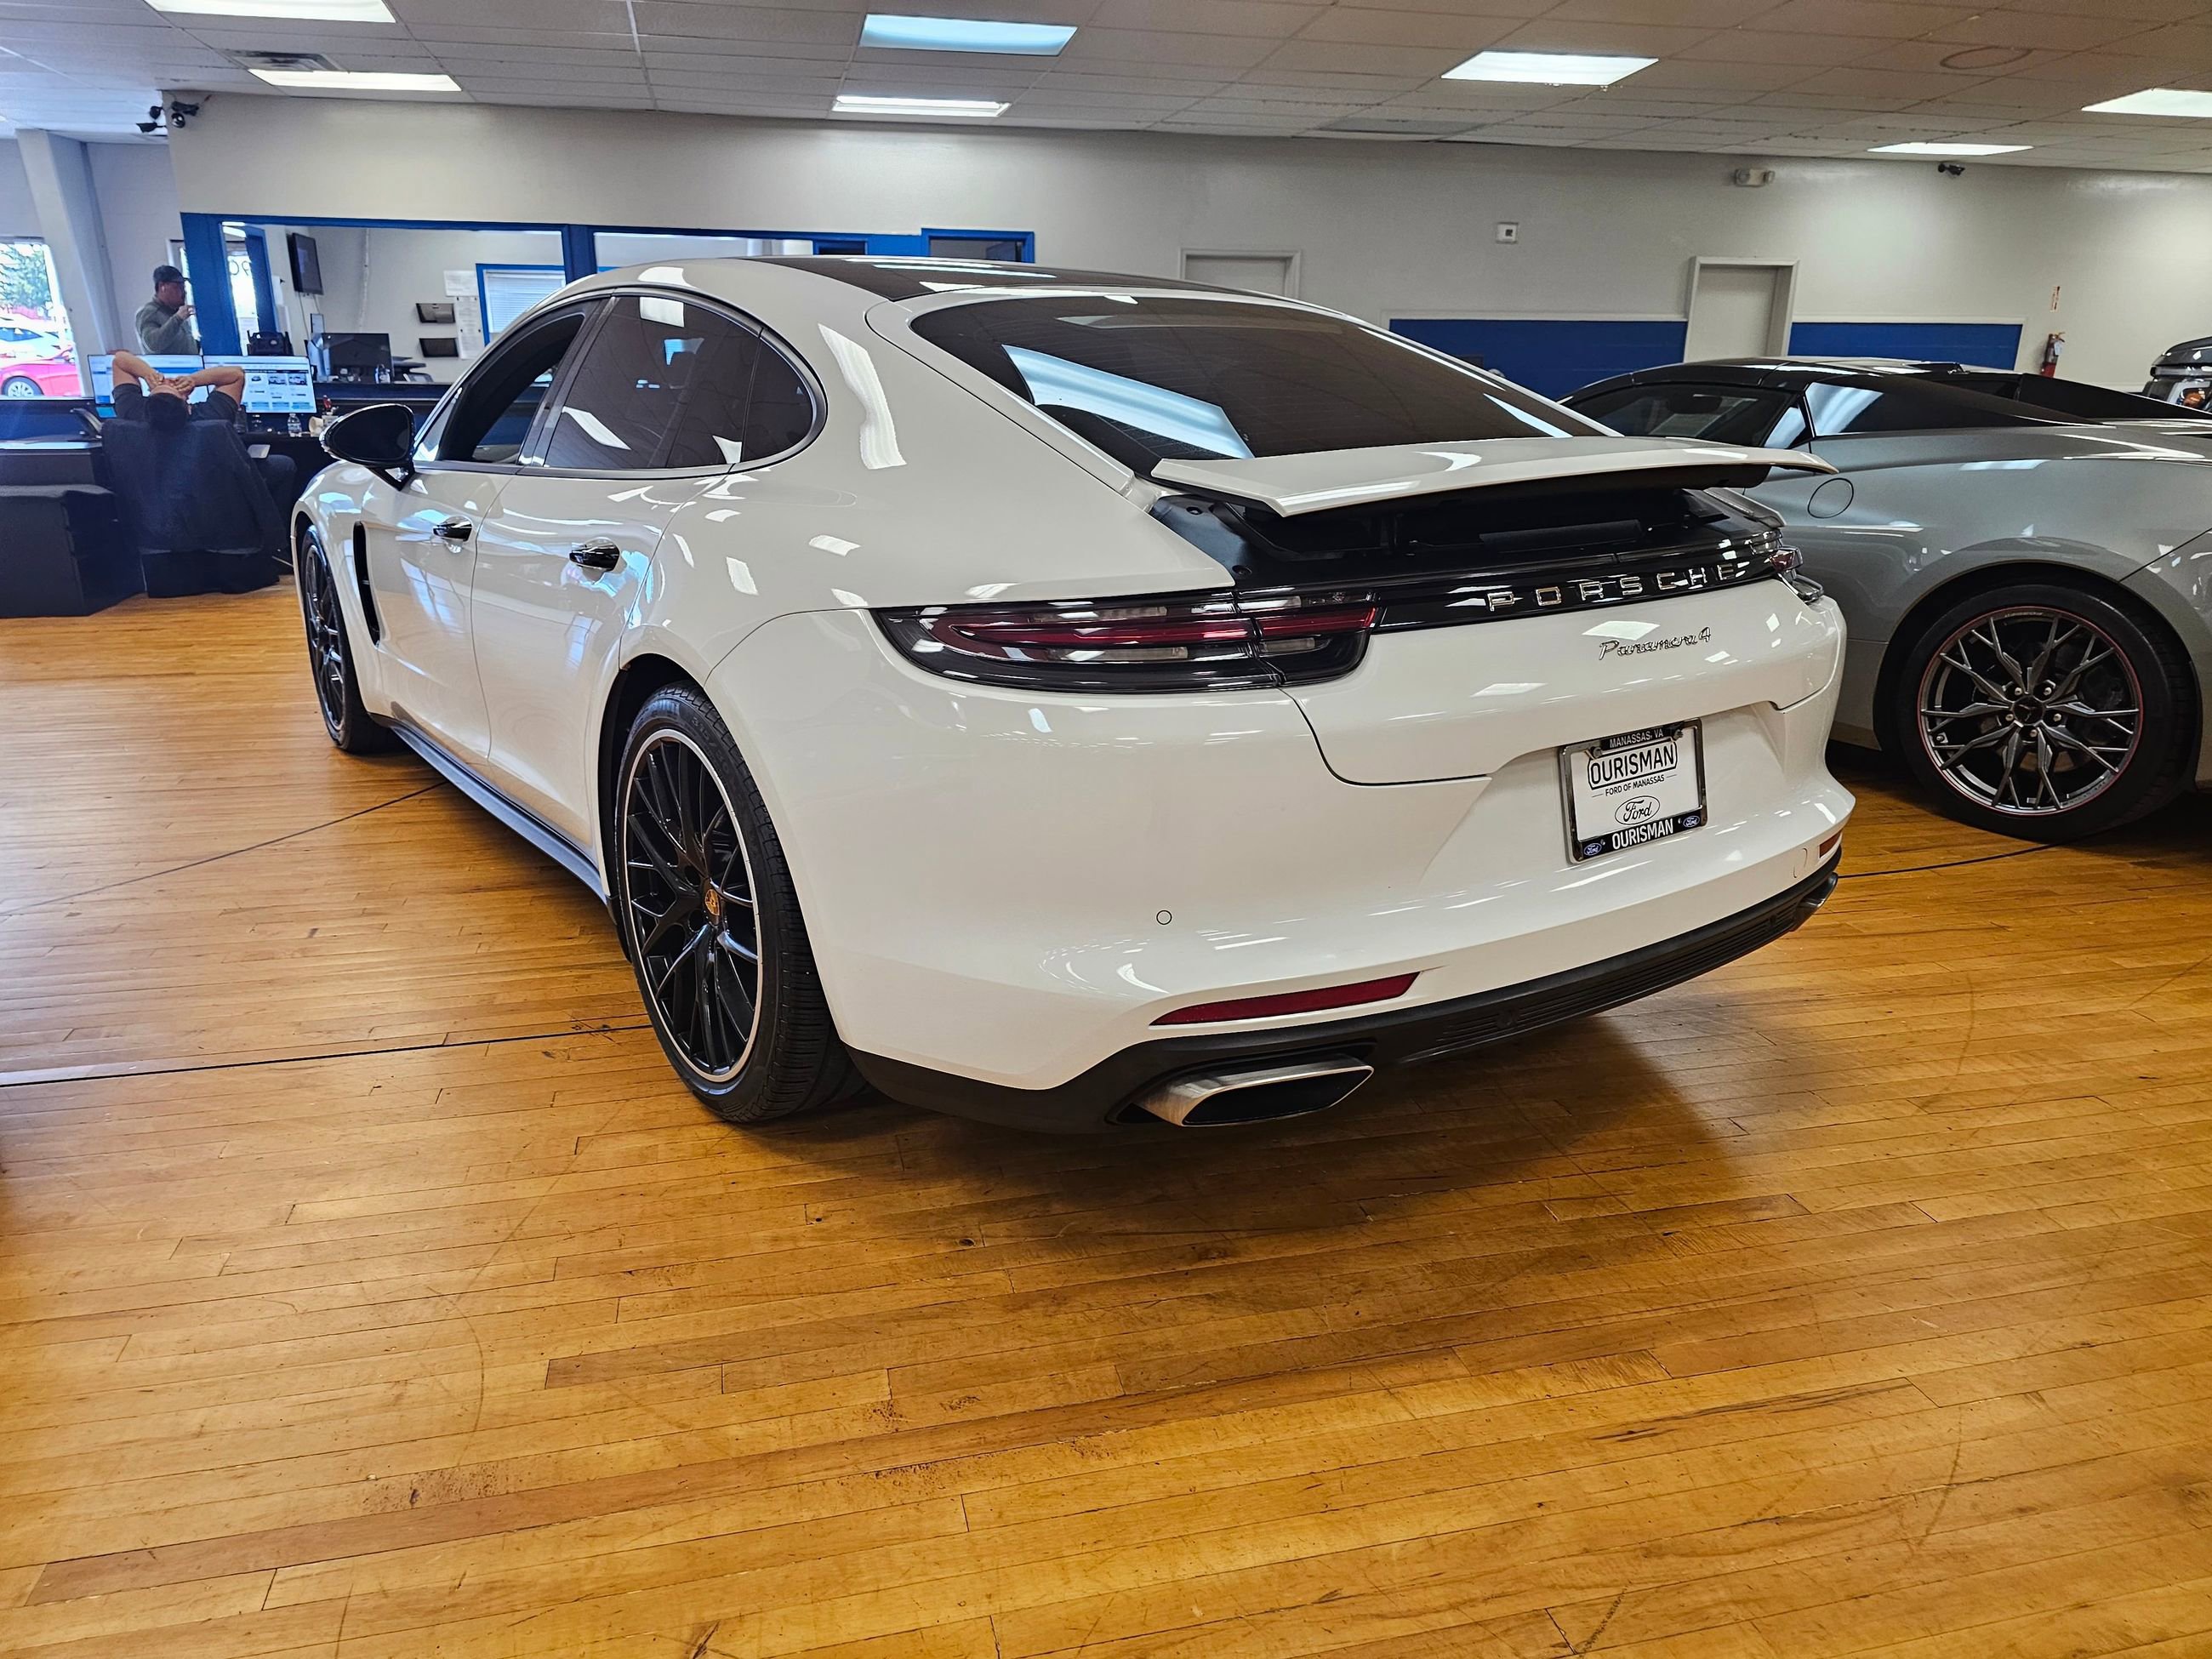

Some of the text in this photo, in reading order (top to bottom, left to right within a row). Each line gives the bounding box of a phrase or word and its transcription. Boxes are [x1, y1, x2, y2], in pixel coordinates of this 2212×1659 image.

[1487, 563, 1735, 611] PORSCHE
[1599, 635, 1697, 660] Panamera
[1654, 727, 1664, 738] VA
[1590, 744, 1674, 784] OURISMAN
[1605, 774, 1665, 796] FORD OF MANASSAS
[1622, 799, 1653, 822] Ford
[1684, 816, 1699, 827] Ford
[1611, 818, 1673, 850] OURISMAN
[1585, 844, 1600, 854] Ford
